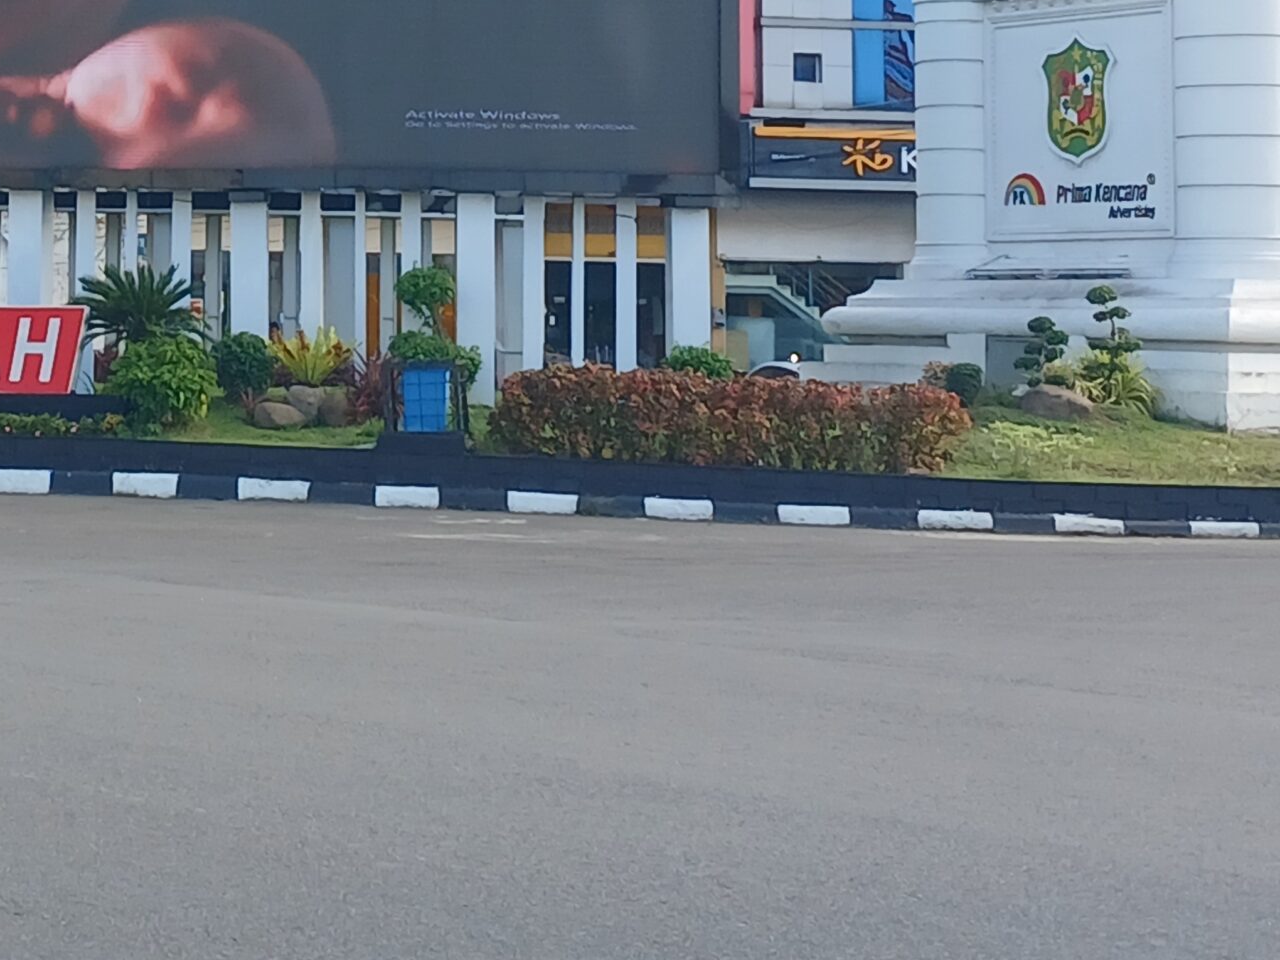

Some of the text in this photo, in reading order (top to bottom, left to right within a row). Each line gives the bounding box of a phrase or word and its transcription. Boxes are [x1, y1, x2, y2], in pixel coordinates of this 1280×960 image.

[405, 108, 560, 121] Activate Windows
[405, 120, 424, 128] Go
[428, 120, 441, 129] to
[444, 120, 498, 130] Settings
[502, 121, 515, 129] to
[519, 121, 570, 130] activate
[1012, 190, 1026, 206] PK
[1056, 182, 1148, 204] Prima Kencana
